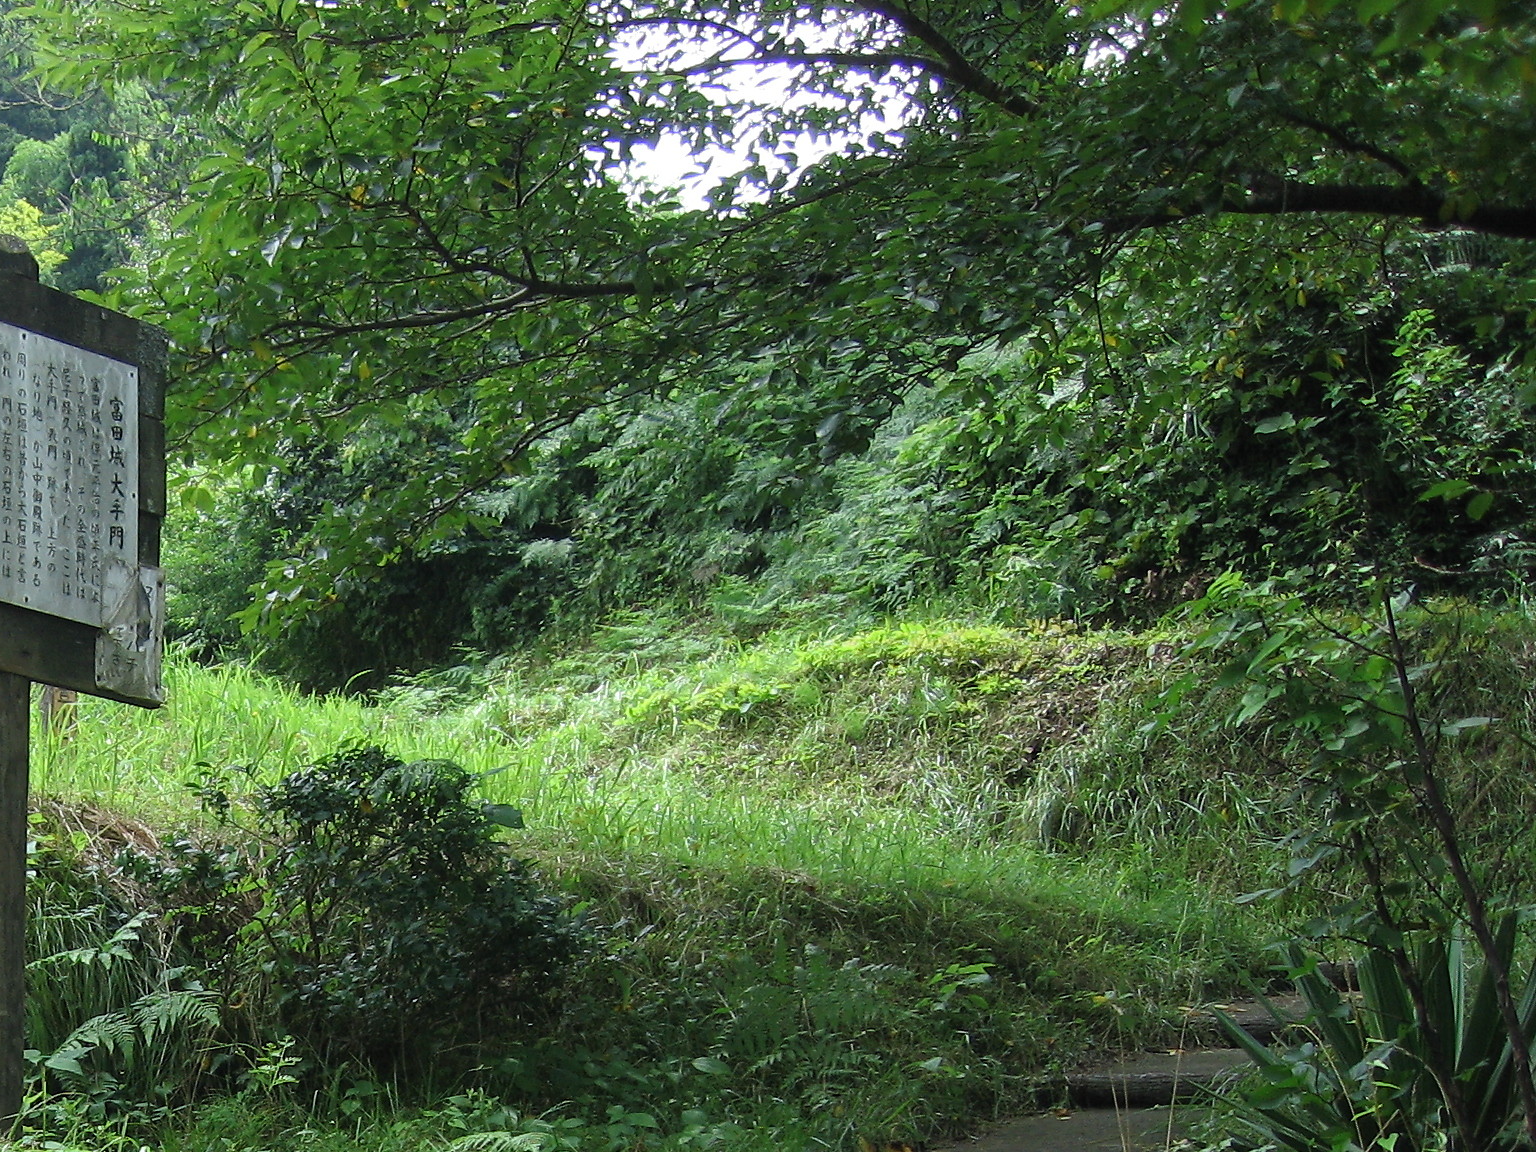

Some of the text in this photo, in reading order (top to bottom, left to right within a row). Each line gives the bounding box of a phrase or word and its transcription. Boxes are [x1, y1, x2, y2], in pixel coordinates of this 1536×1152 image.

[108, 396, 126, 550] 富田城大手門
